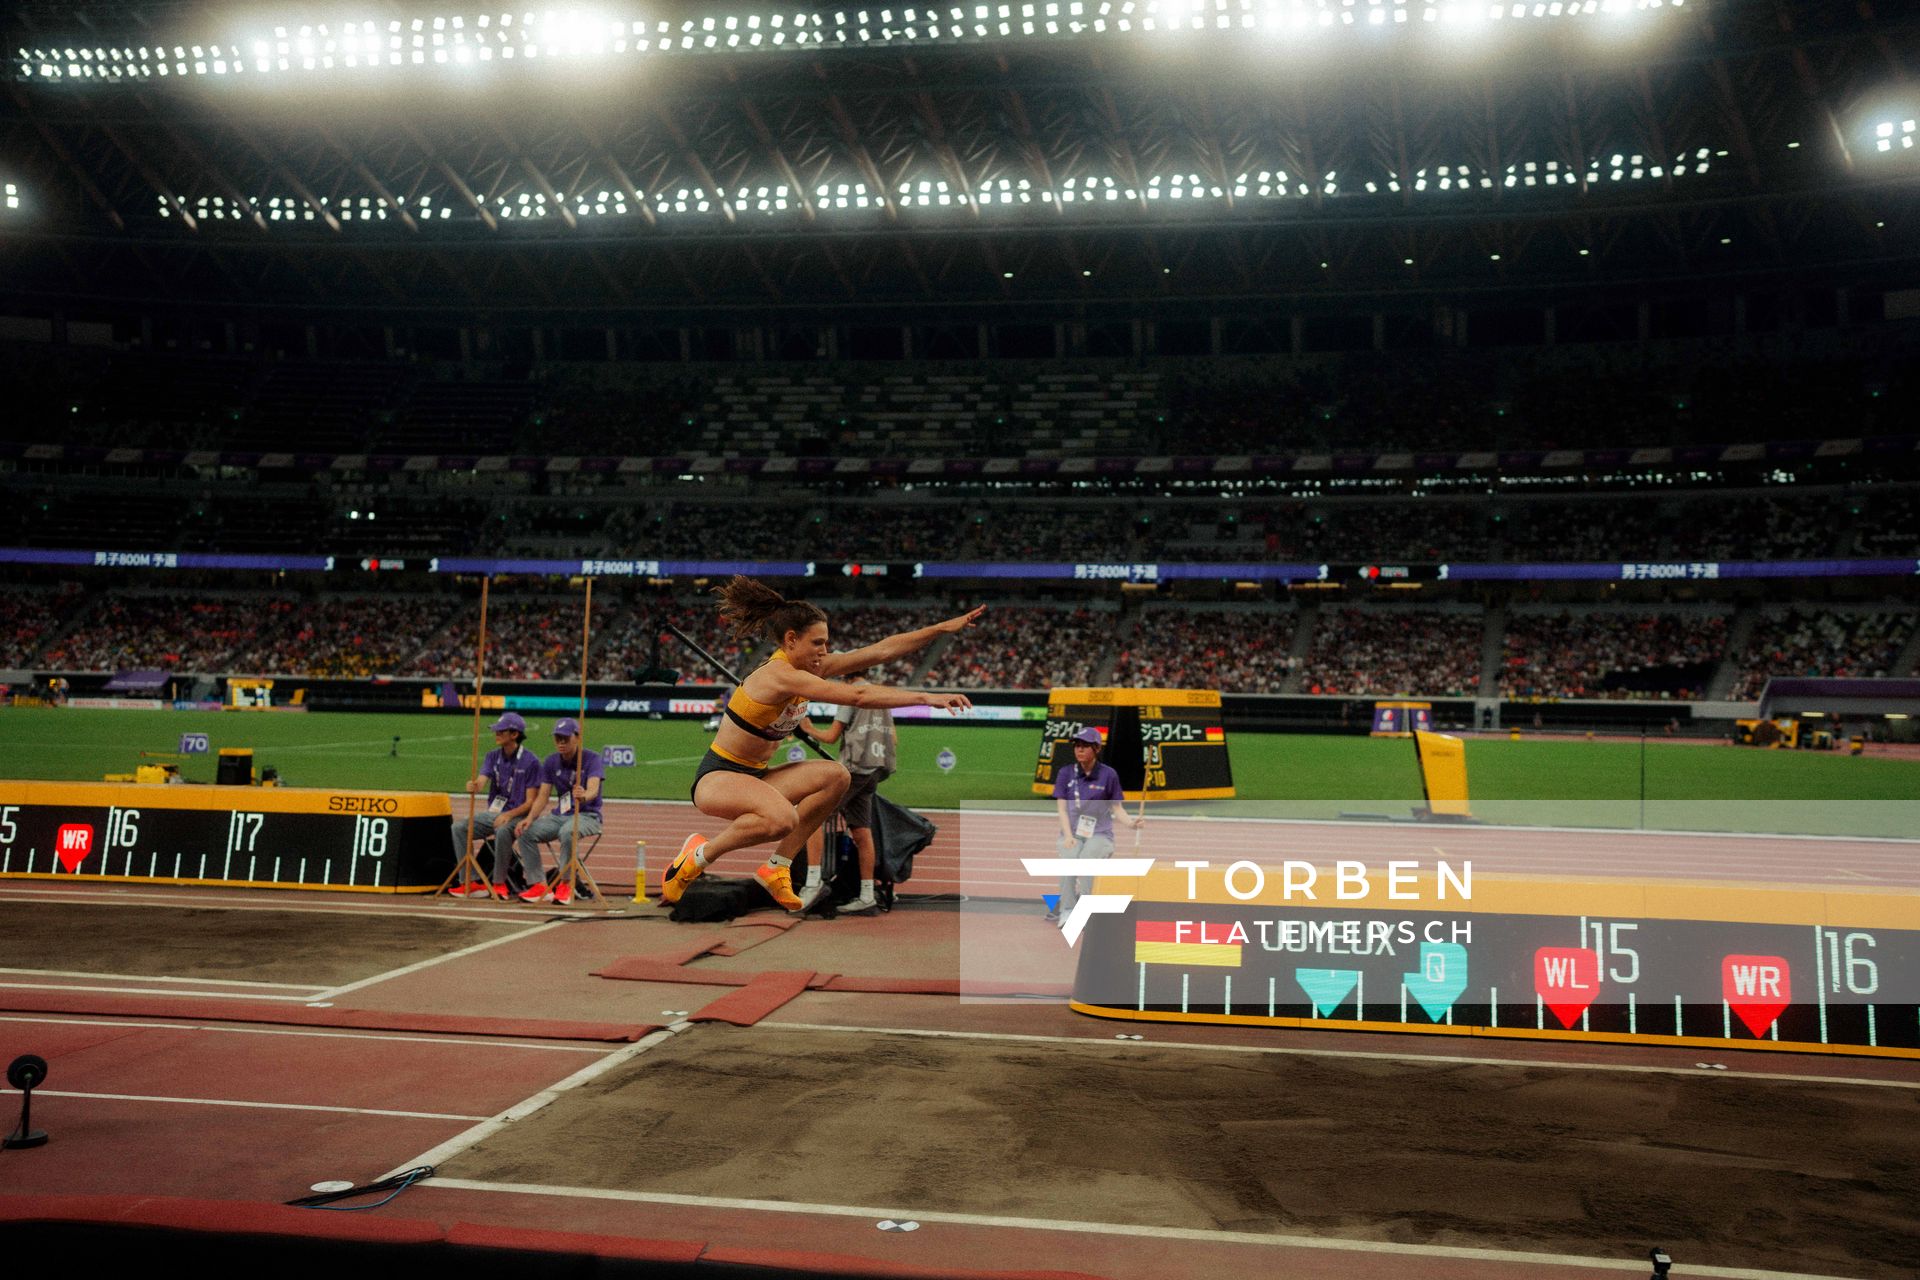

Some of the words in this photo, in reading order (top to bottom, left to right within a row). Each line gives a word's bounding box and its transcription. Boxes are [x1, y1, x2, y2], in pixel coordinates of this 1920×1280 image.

[186, 737, 207, 751] 70
[1140, 723, 1202, 741] ジョワイユー
[612, 750, 633, 764] 80
[328, 795, 398, 813] SEIKO
[0, 806, 20, 843] 5
[62, 829, 88, 850] WR
[112, 809, 139, 847] 16
[235, 812, 264, 851] 17
[359, 817, 389, 857] 18
[1589, 921, 1639, 984] 15
[1824, 930, 1879, 995] 16
[1543, 956, 1589, 990] WL
[1732, 964, 1781, 998] WR
